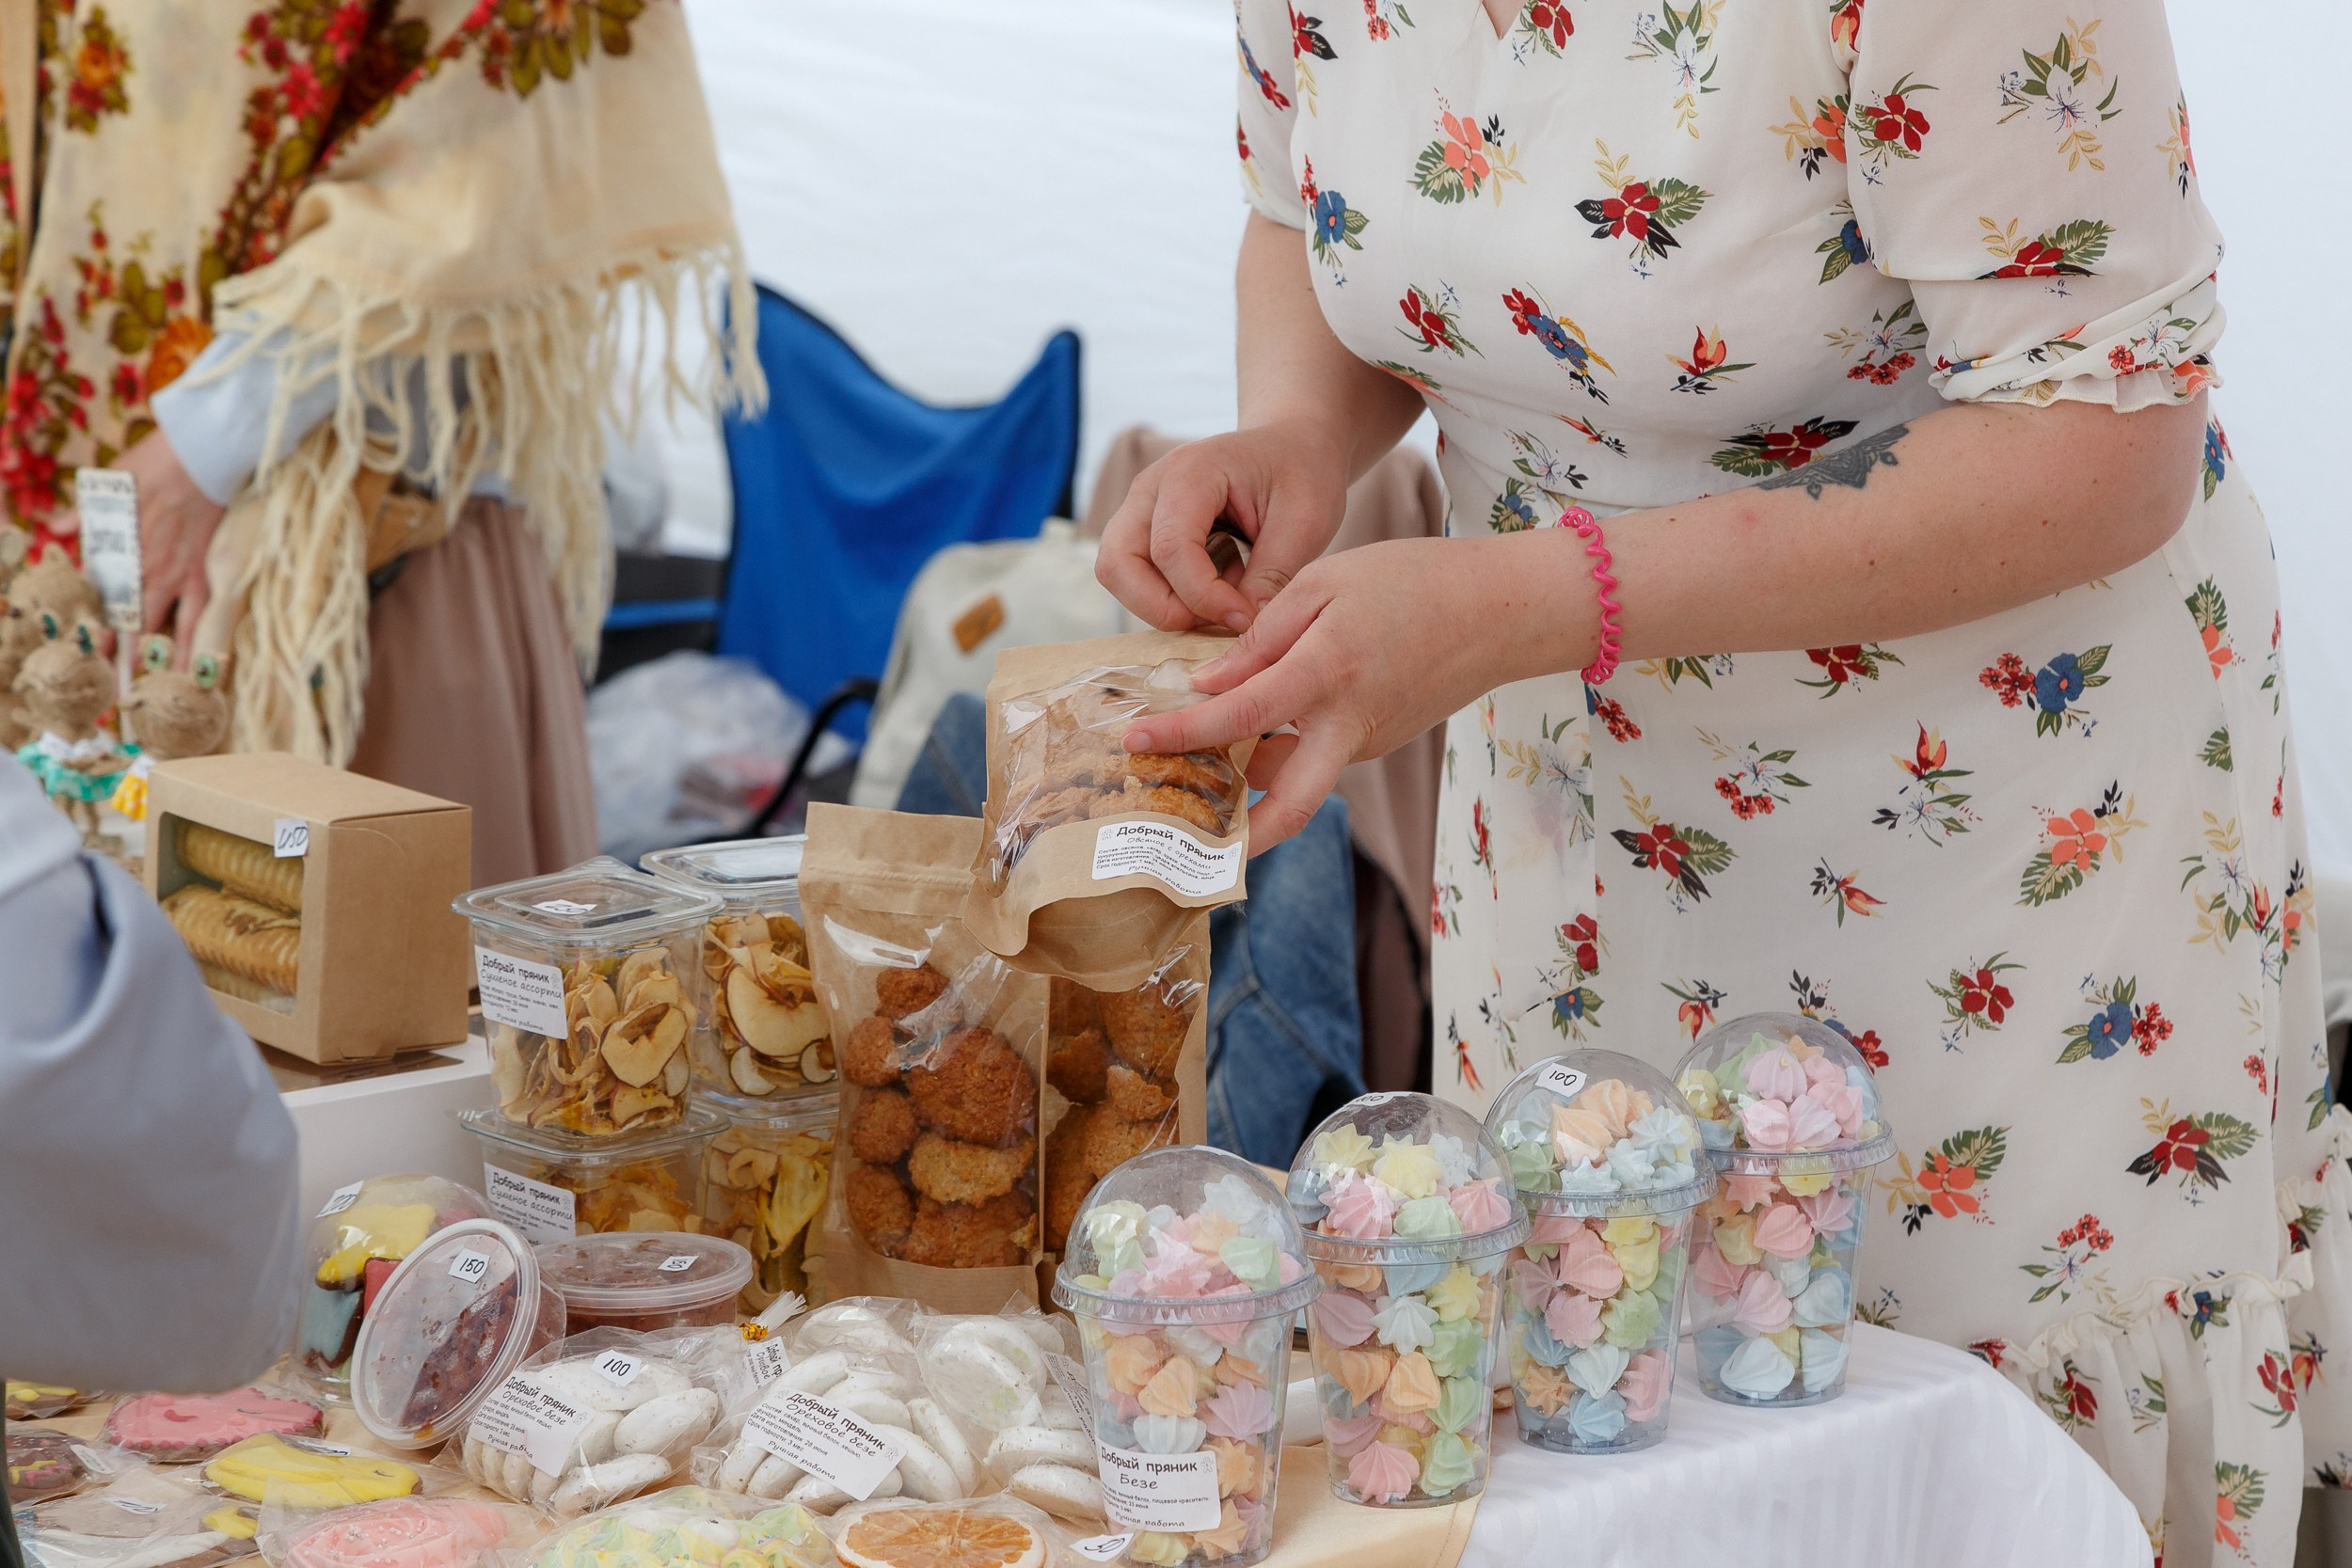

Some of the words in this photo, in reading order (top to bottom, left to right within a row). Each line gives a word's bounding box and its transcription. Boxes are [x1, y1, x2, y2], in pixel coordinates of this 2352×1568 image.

[1117, 826, 1173, 841] Добрый
[1180, 839, 1225, 861] пряник
[1127, 837, 1165, 847] Овсяное
[1175, 850, 1211, 869] орехами
[1166, 877, 1201, 894] работа
[484, 955, 515, 974] Добрый
[519, 969, 549, 984] пряник
[481, 969, 517, 987] Сушеное
[521, 983, 562, 1000] ассорти
[1549, 1070, 1577, 1085] 100
[494, 1172, 526, 1194] Добрый
[529, 1188, 561, 1204] пряник
[491, 1185, 527, 1206] Сушеное
[531, 1202, 572, 1221] ассорти
[459, 1258, 485, 1274] 150
[603, 1358, 630, 1376] 100
[502, 1391, 543, 1413] Ореховое
[544, 1411, 566, 1425] безе
[504, 1376, 541, 1399] Добрый
[540, 1394, 576, 1418] пряник
[747, 1418, 761, 1430] Срок
[751, 1412, 765, 1422] Дата
[787, 1393, 839, 1419] Добрый
[841, 1418, 886, 1450] пряник
[787, 1403, 846, 1438] Ореховое
[850, 1436, 876, 1457] безе
[488, 1434, 508, 1447] Ручная
[768, 1440, 800, 1460] Ручная
[800, 1459, 835, 1481] работа
[1101, 1447, 1139, 1470] Добрый
[1146, 1462, 1198, 1476] пряник
[1120, 1473, 1158, 1489] Безе
[1115, 1512, 1140, 1524] Ручная
[1084, 1538, 1125, 1553] 50
